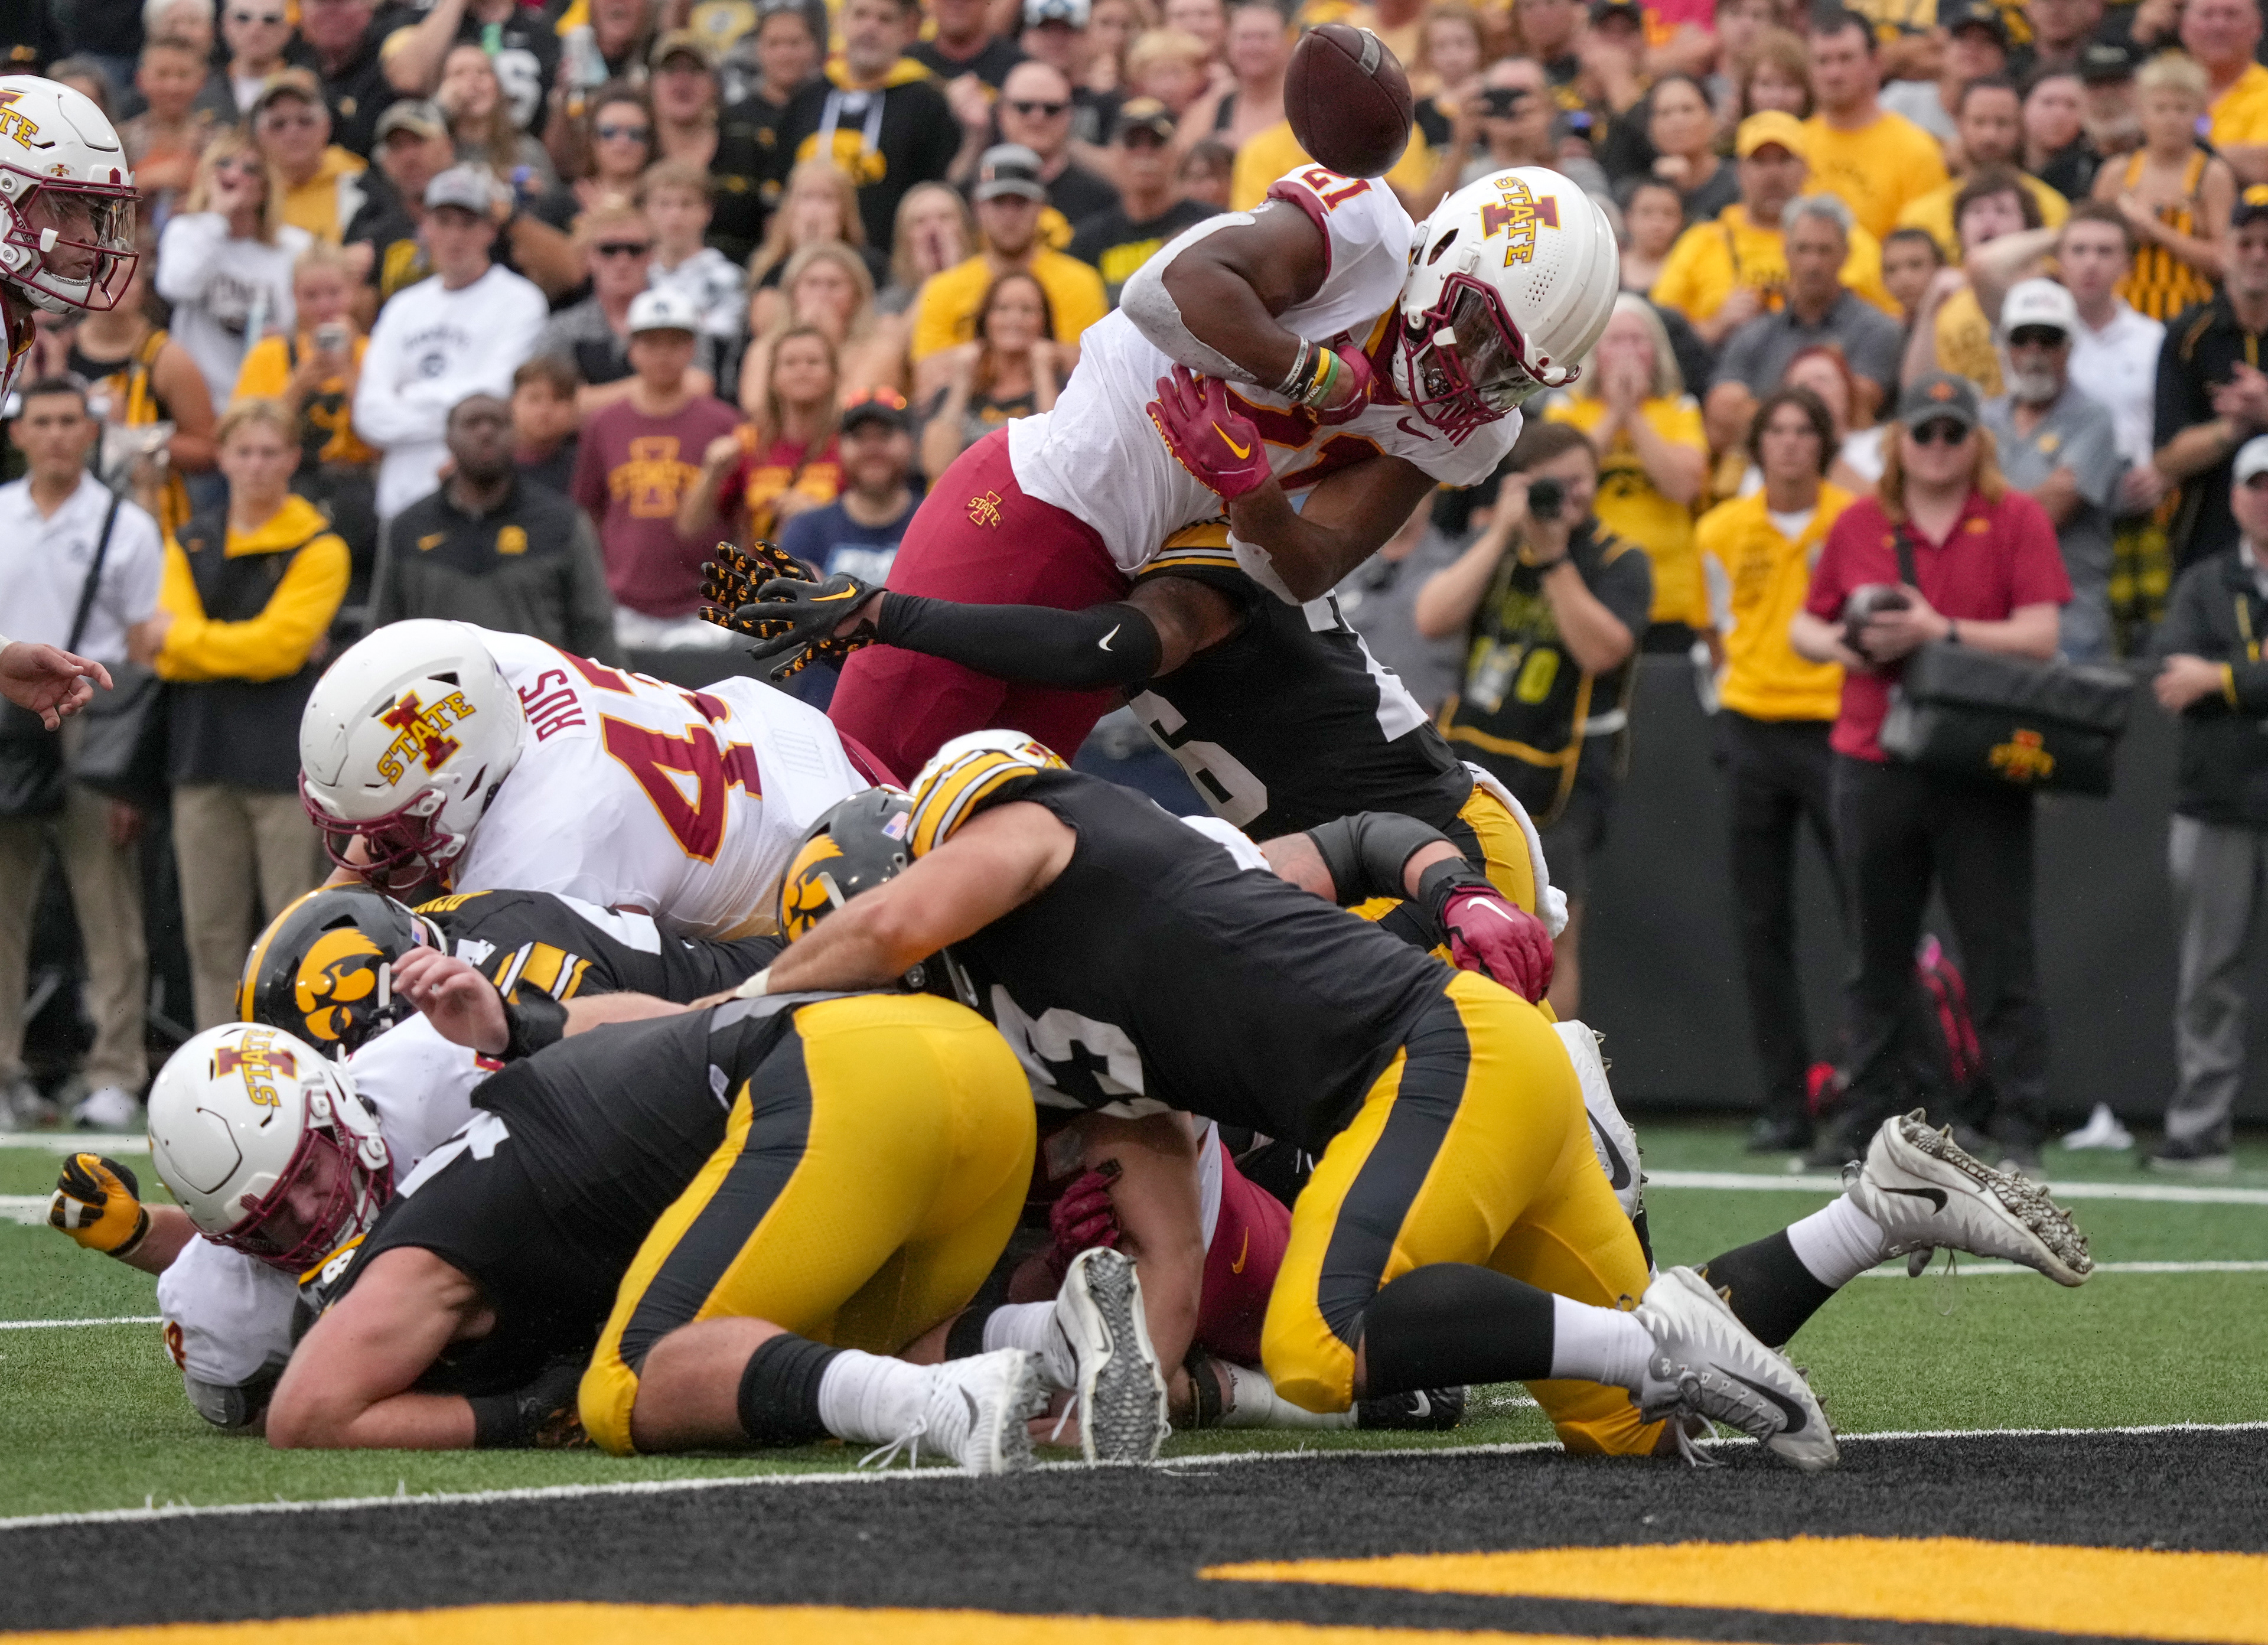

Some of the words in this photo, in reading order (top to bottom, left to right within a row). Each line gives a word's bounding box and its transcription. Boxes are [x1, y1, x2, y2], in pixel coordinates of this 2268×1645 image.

[1493, 176, 1537, 268] STATE
[967, 497, 1001, 527] STATE
[750, 569, 758, 585] IOWA
[376, 690, 477, 787] STATE
[517, 669, 587, 743] RUS
[240, 1028, 282, 1107] STATE
